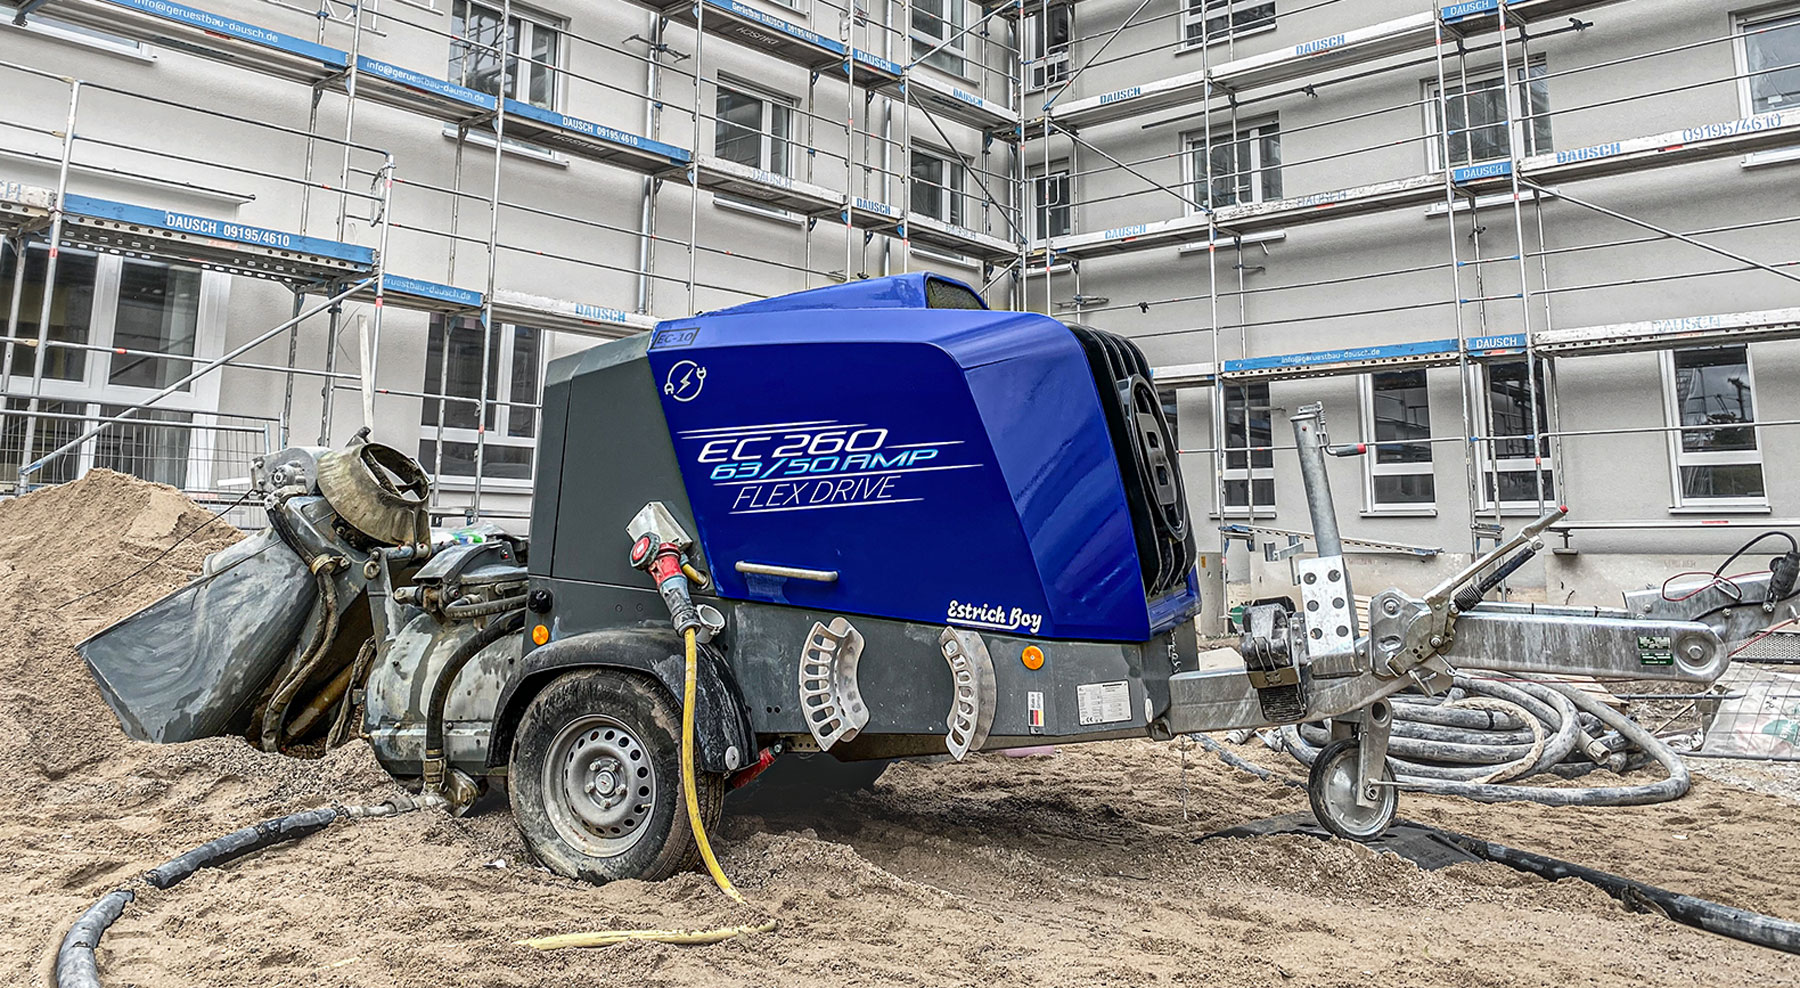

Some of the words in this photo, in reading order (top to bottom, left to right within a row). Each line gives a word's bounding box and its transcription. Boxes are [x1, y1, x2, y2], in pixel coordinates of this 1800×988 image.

[1450, 0, 1489, 16] DAUSCH
[762, 13, 785, 29] DAUSCH
[1295, 34, 1345, 55] DAUSCH
[857, 50, 892, 72] DAUSCH
[366, 61, 485, 103] info@geruestbau-dausch.de
[953, 88, 983, 107] DAUSCH
[1100, 86, 1141, 104] DAUSCH
[562, 116, 594, 133] DAUSCH
[596, 126, 638, 145] 09195/4610
[1556, 142, 1621, 164] DAUSCH
[1682, 112, 1783, 142] 09195/4610
[1463, 164, 1504, 178] DAUSCH
[856, 197, 891, 215] DAUSCH
[165, 214, 217, 234] DAUSCH
[223, 224, 290, 247] 09195/4610
[1105, 224, 1146, 239] DAUSCH
[575, 303, 626, 322] DAUSCH
[657, 332, 694, 345] EC-10
[1476, 336, 1517, 349] DAUSCH
[697, 436, 772, 463] EC
[771, 428, 889, 459] 260
[709, 456, 840, 480] 63/50
[839, 449, 939, 472] AMP
[732, 482, 809, 508] FLEX
[809, 475, 902, 503] DRIVE
[947, 600, 1006, 624] Estrich
[1008, 607, 1042, 633] Boy
